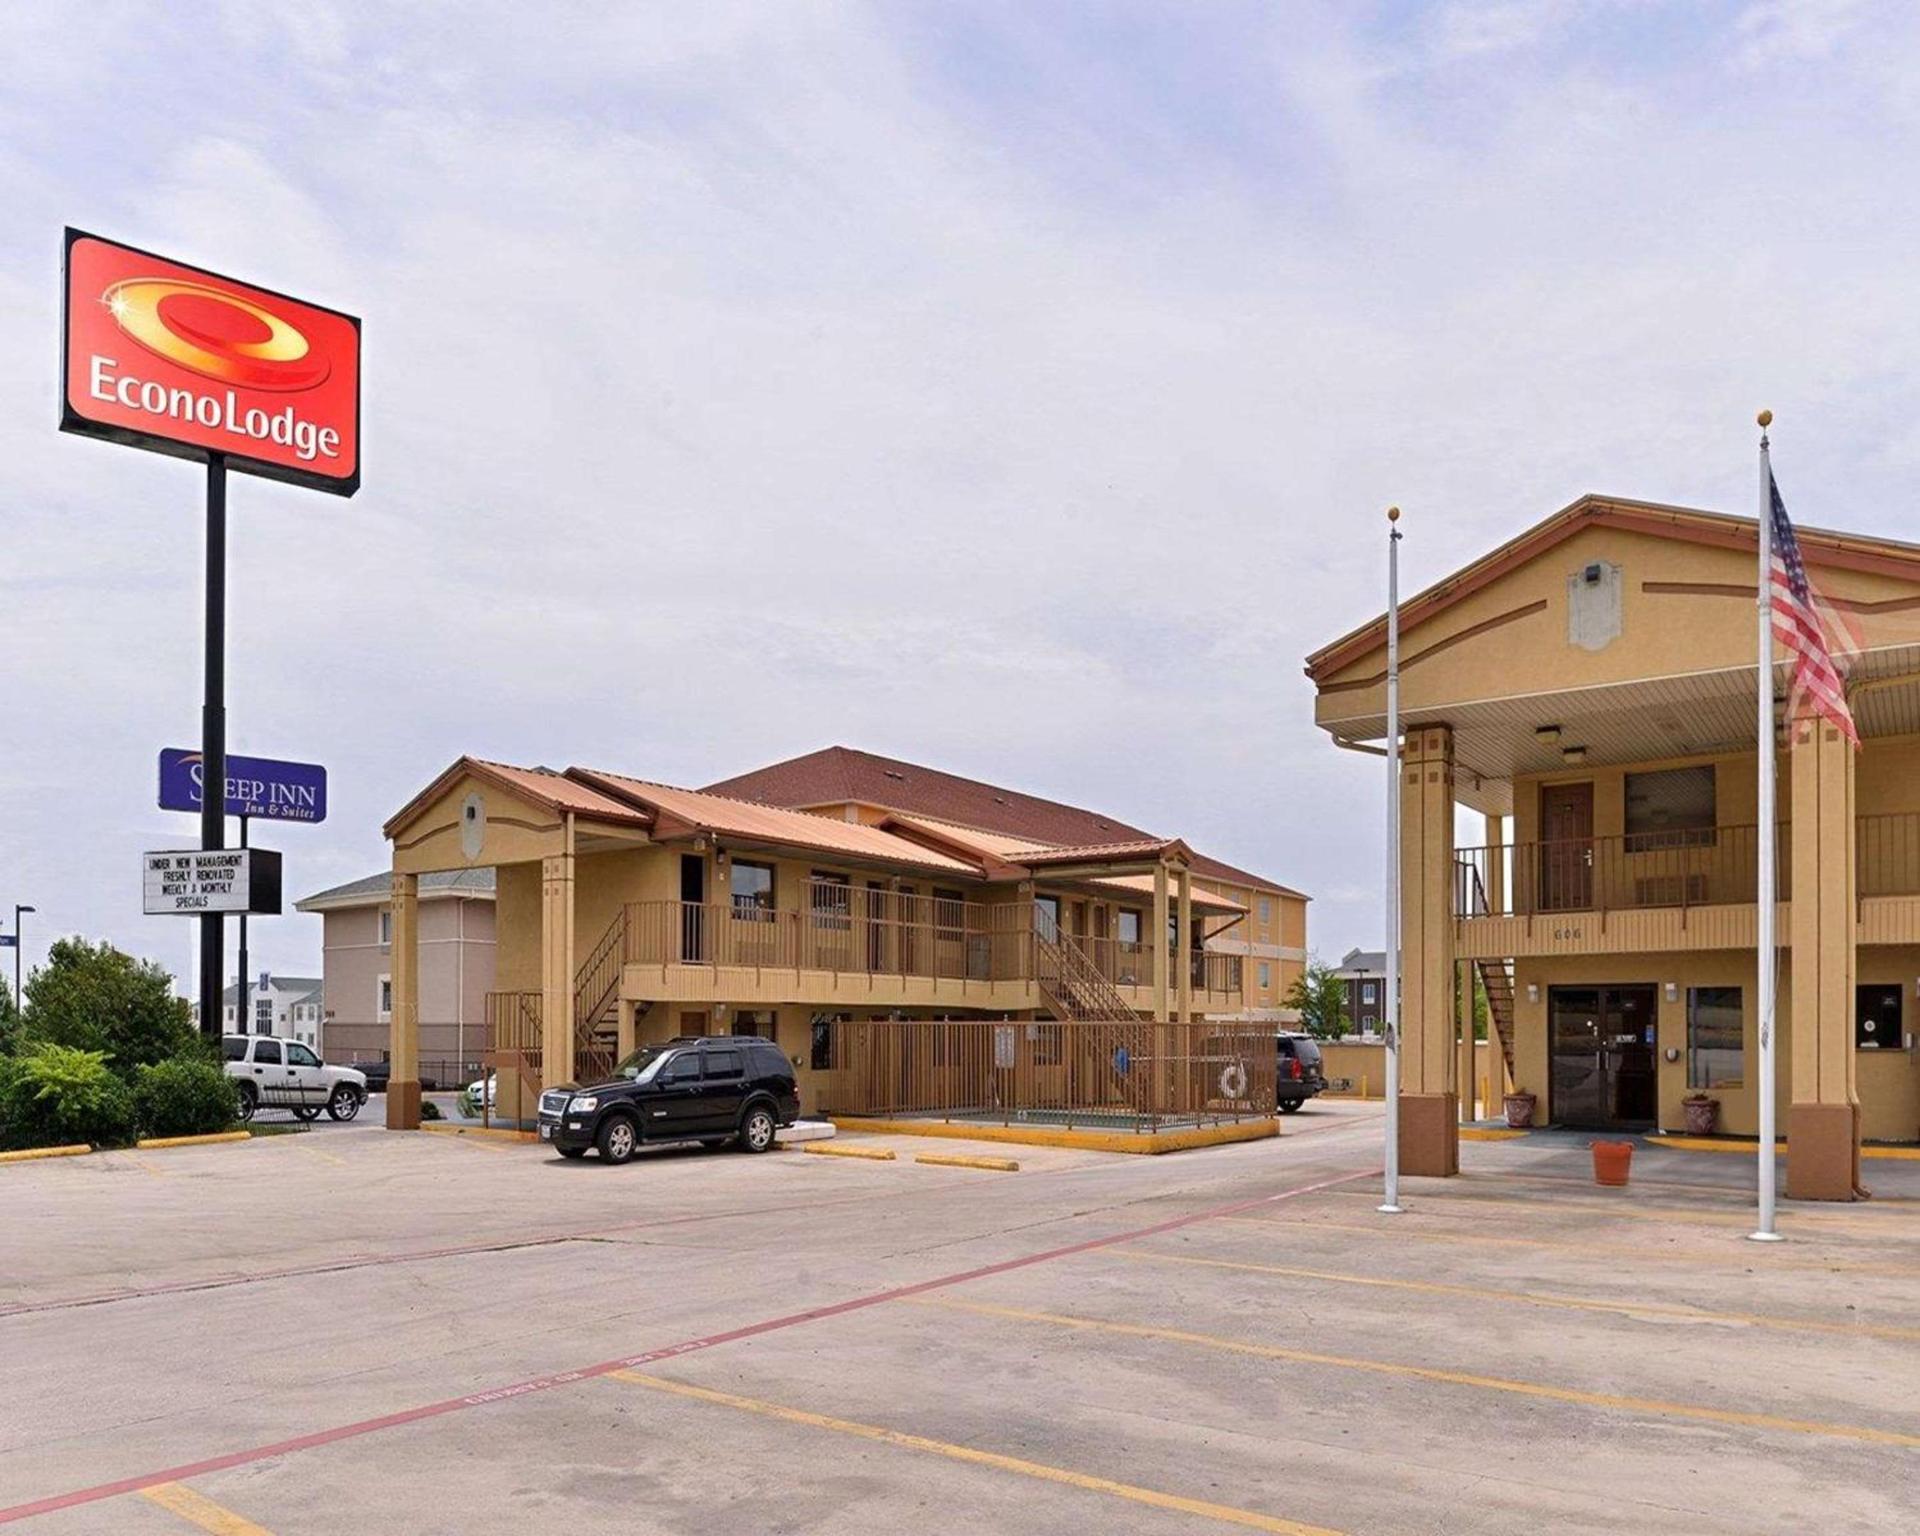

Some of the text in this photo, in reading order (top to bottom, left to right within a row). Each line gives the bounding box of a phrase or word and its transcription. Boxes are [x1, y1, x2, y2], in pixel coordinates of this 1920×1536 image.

[90, 354, 341, 461] EconoLodge
[189, 763, 316, 806] SEEP INN
[244, 802, 315, 819] Inn & Suites
[149, 854, 242, 870] UNDER NEW MANAGEMENT
[163, 868, 235, 882] FRESHLY RENOVATED
[162, 883, 187, 895] WEEKLY
[201, 881, 232, 894] MONTHLY
[176, 896, 208, 908] SPECIALS
